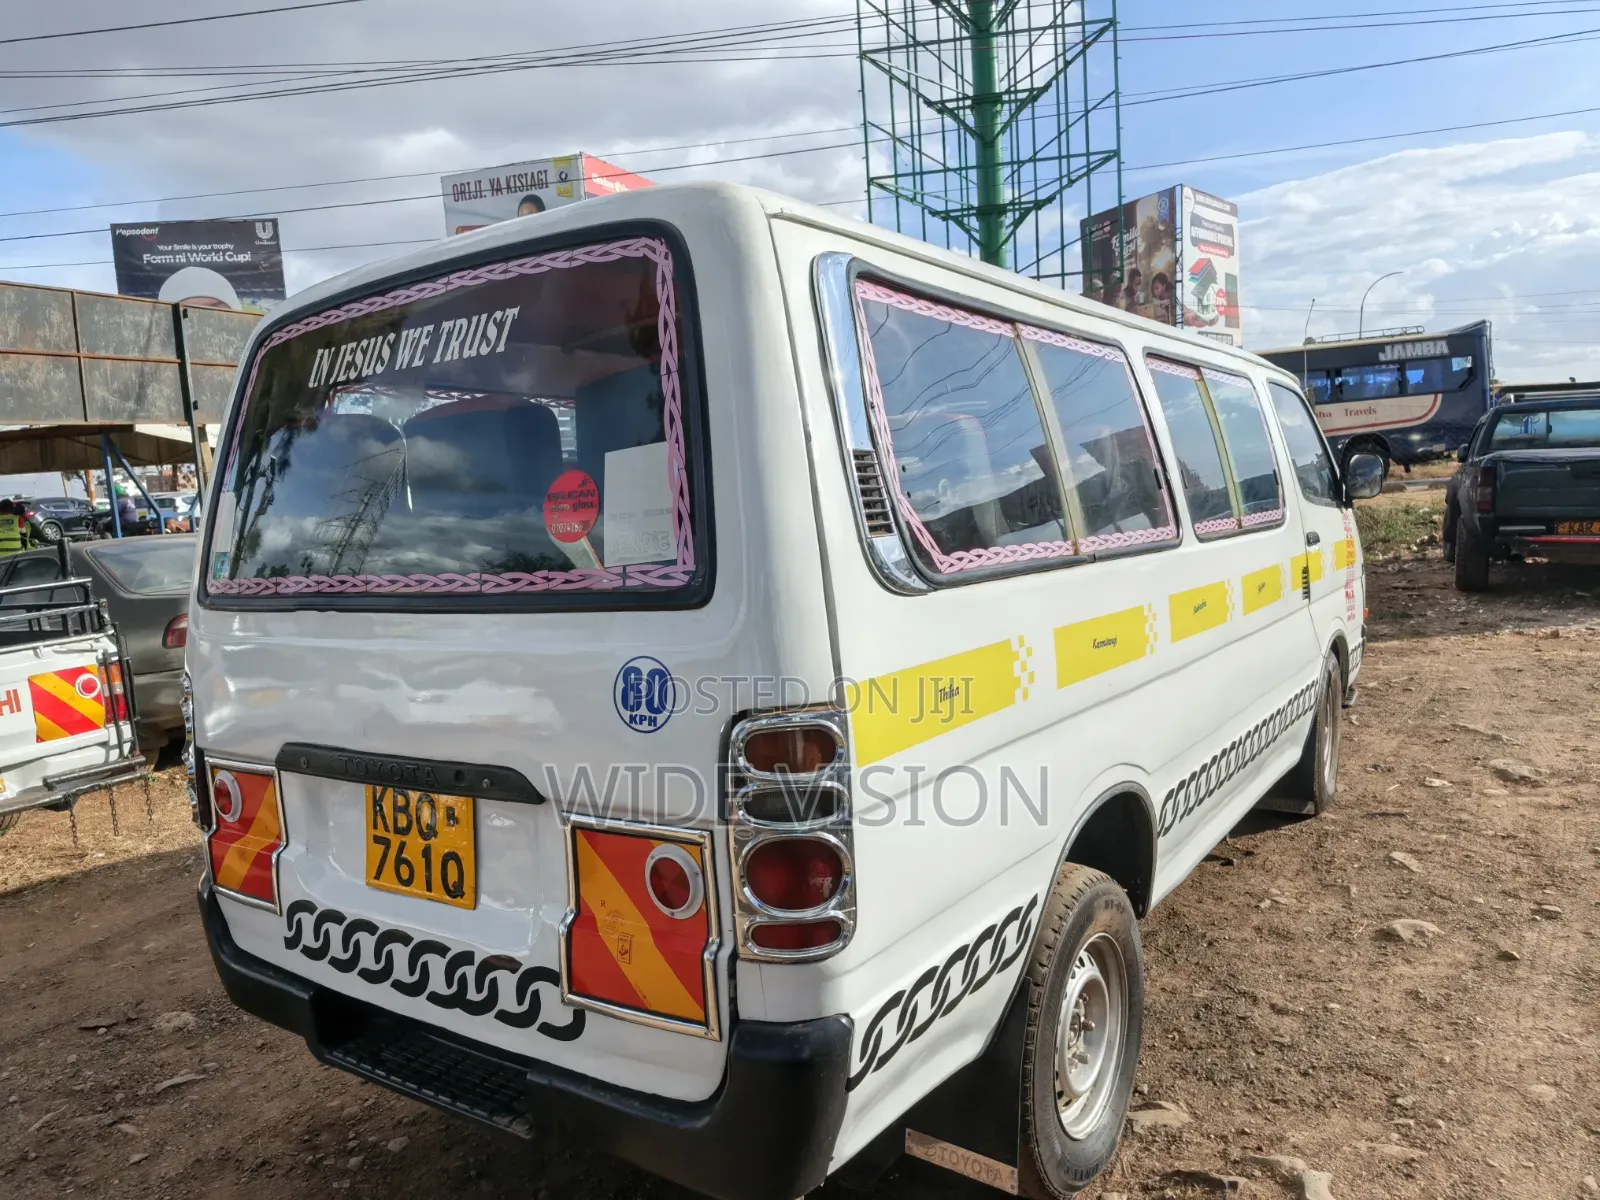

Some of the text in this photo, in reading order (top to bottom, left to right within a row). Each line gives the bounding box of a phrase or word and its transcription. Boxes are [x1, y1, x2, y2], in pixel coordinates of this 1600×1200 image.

[489, 177, 503, 198] YA
[505, 169, 550, 195] KISIAGI
[116, 227, 159, 238] Pepsodent
[143, 251, 252, 265] Form ni World Cup!
[192, 243, 198, 251] is
[198, 243, 211, 251] your
[212, 243, 235, 251] trophy
[308, 305, 521, 388] IN JESUS WE TRUST
[1378, 339, 1450, 362] JAMBA
[1344, 406, 1377, 418] Travels
[547, 489, 595, 502] PELICAN
[621, 666, 668, 715] 80
[628, 713, 658, 727] KPH
[338, 755, 440, 787] TOYOTA
[372, 786, 438, 842] KBQ
[372, 835, 466, 900] 761Q
[938, 1147, 1005, 1183] TOYOTA
